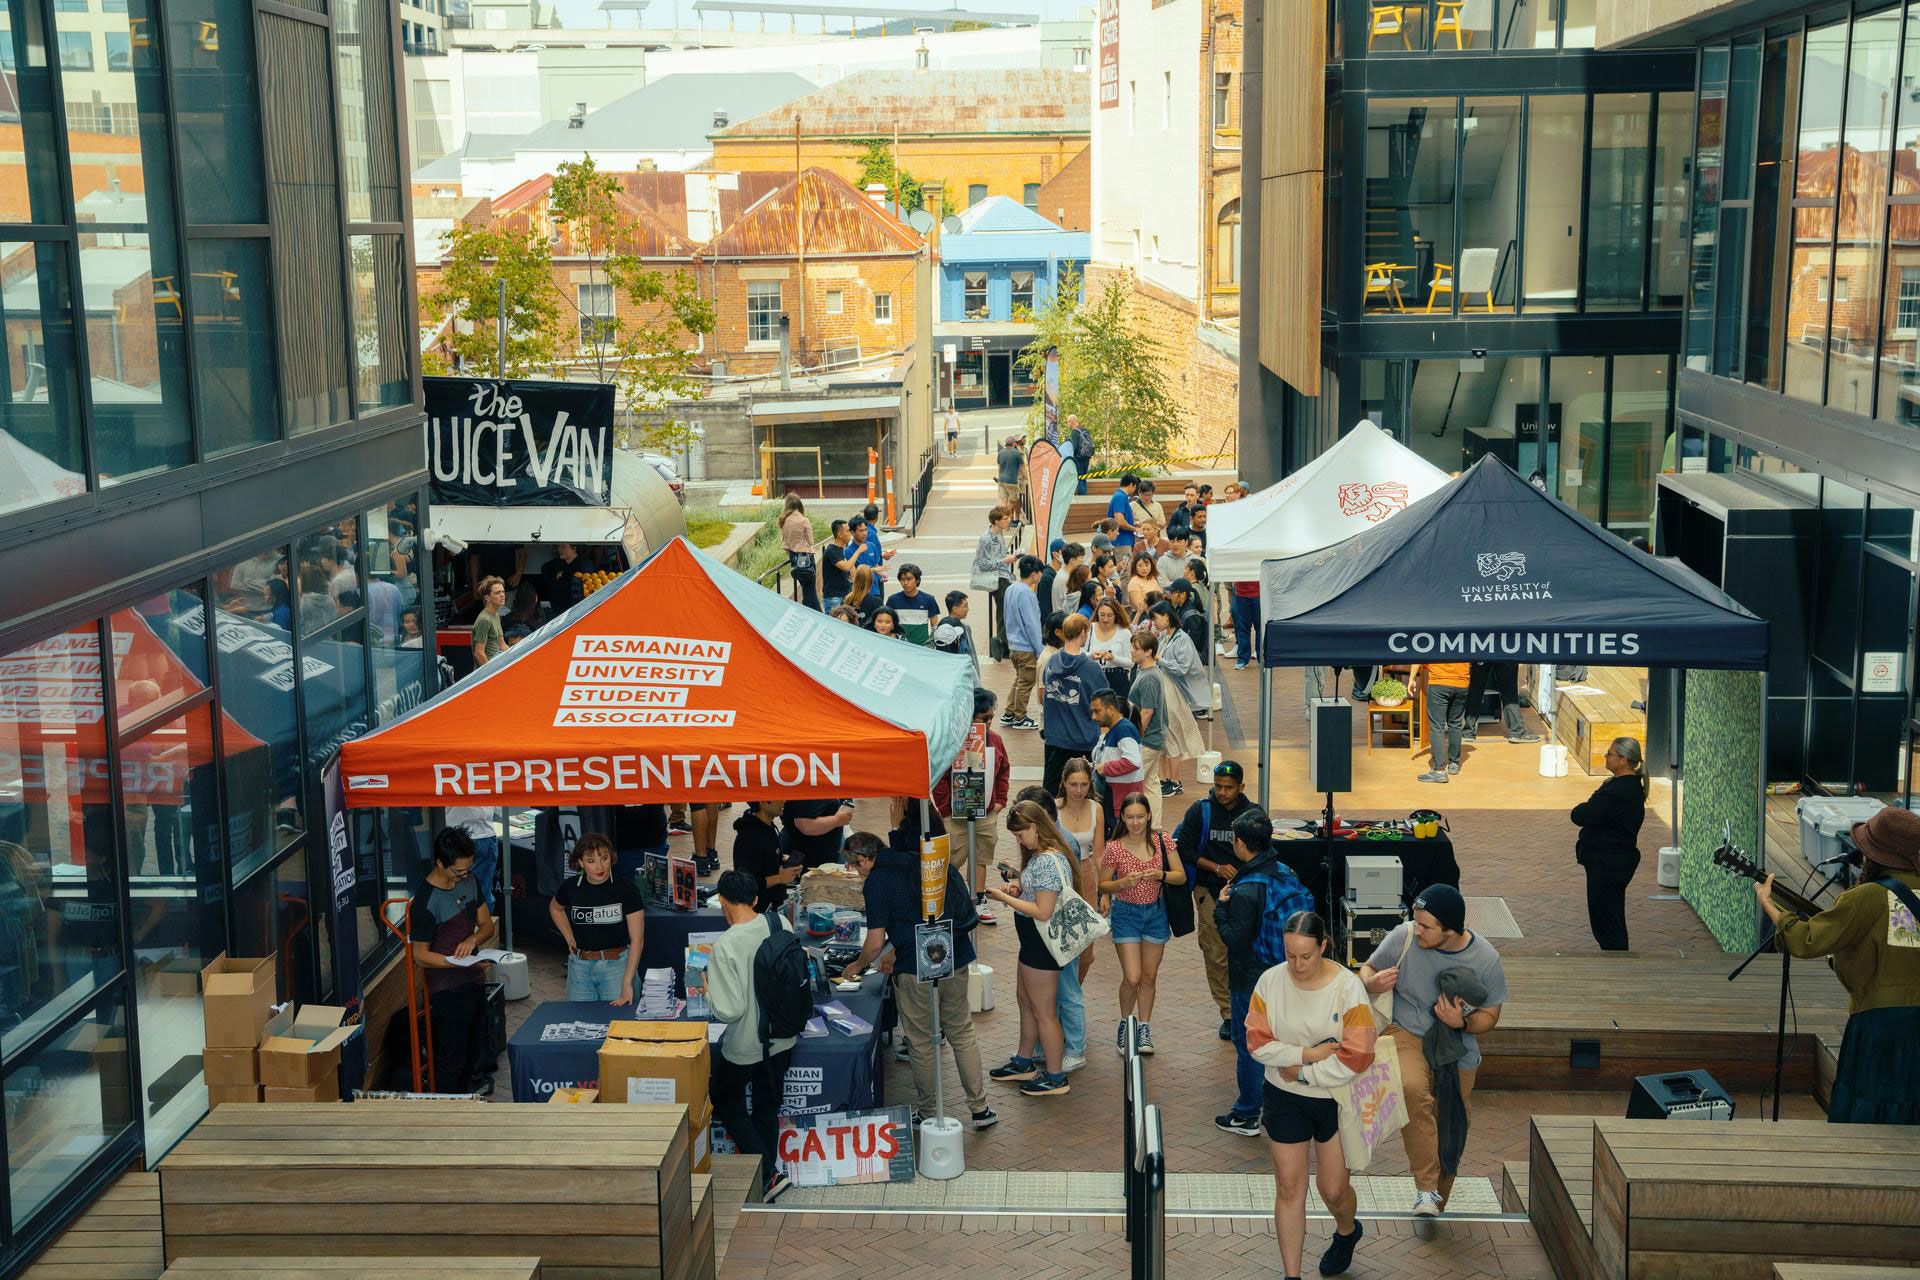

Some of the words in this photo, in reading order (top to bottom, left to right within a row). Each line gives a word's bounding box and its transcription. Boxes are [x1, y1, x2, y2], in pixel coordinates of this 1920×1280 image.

[468, 383, 523, 418] the
[423, 416, 517, 487] UICE
[519, 411, 606, 494] VAN
[1461, 583, 1540, 594] UNIVERSITY
[1541, 582, 1551, 590] of
[1462, 590, 1553, 603] TASMANIA
[582, 640, 725, 659] TASMANIAN
[1388, 632, 1640, 655] COMMUNITIES
[574, 665, 717, 682] UNIVERSITY
[569, 690, 681, 703] STUDENT
[560, 712, 729, 724] ASSOCIATION
[433, 752, 841, 797] REPRESENTATION
[529, 1078, 574, 1094] Your
